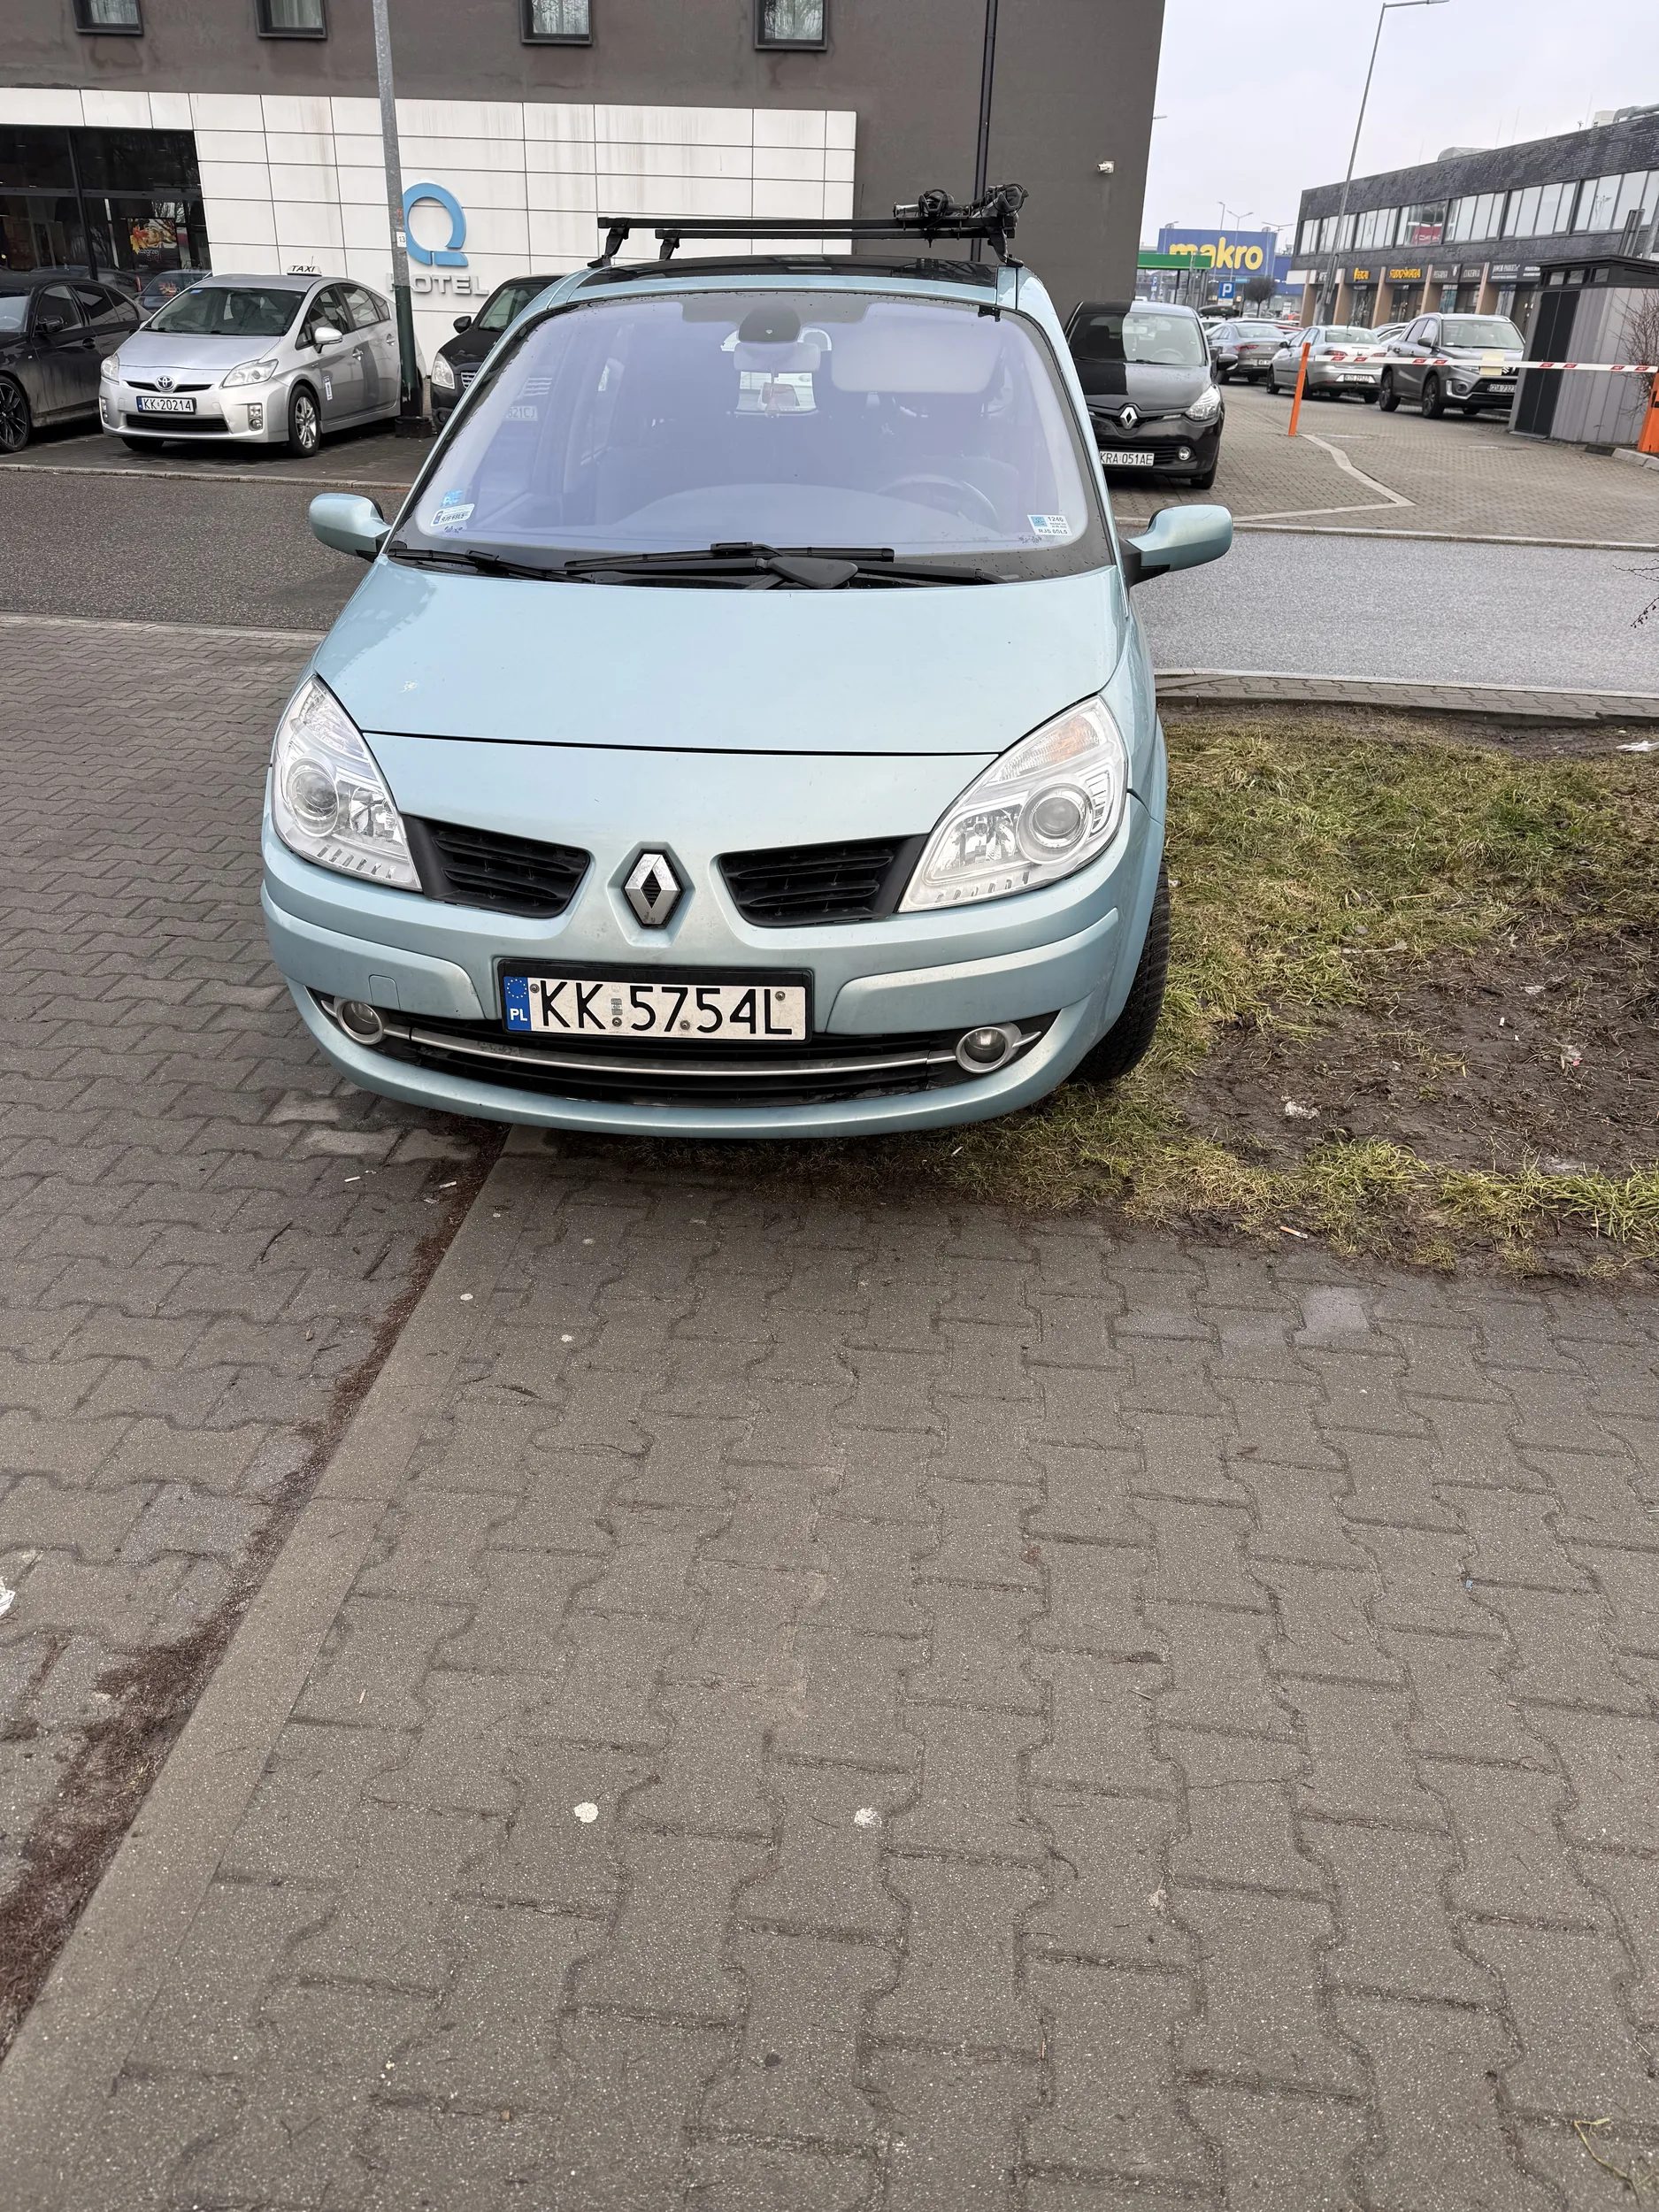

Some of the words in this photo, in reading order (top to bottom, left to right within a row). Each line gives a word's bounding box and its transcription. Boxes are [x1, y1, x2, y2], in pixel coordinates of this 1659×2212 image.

[1222, 283, 1233, 297] P
[143, 398, 157, 410] KK
[159, 399, 191, 411] 20214
[1100, 452, 1118, 464] KRA
[1122, 453, 1154, 465] 051AE
[540, 979, 607, 1030] KK
[629, 984, 794, 1035] 5754L
[510, 1008, 528, 1022] PL
